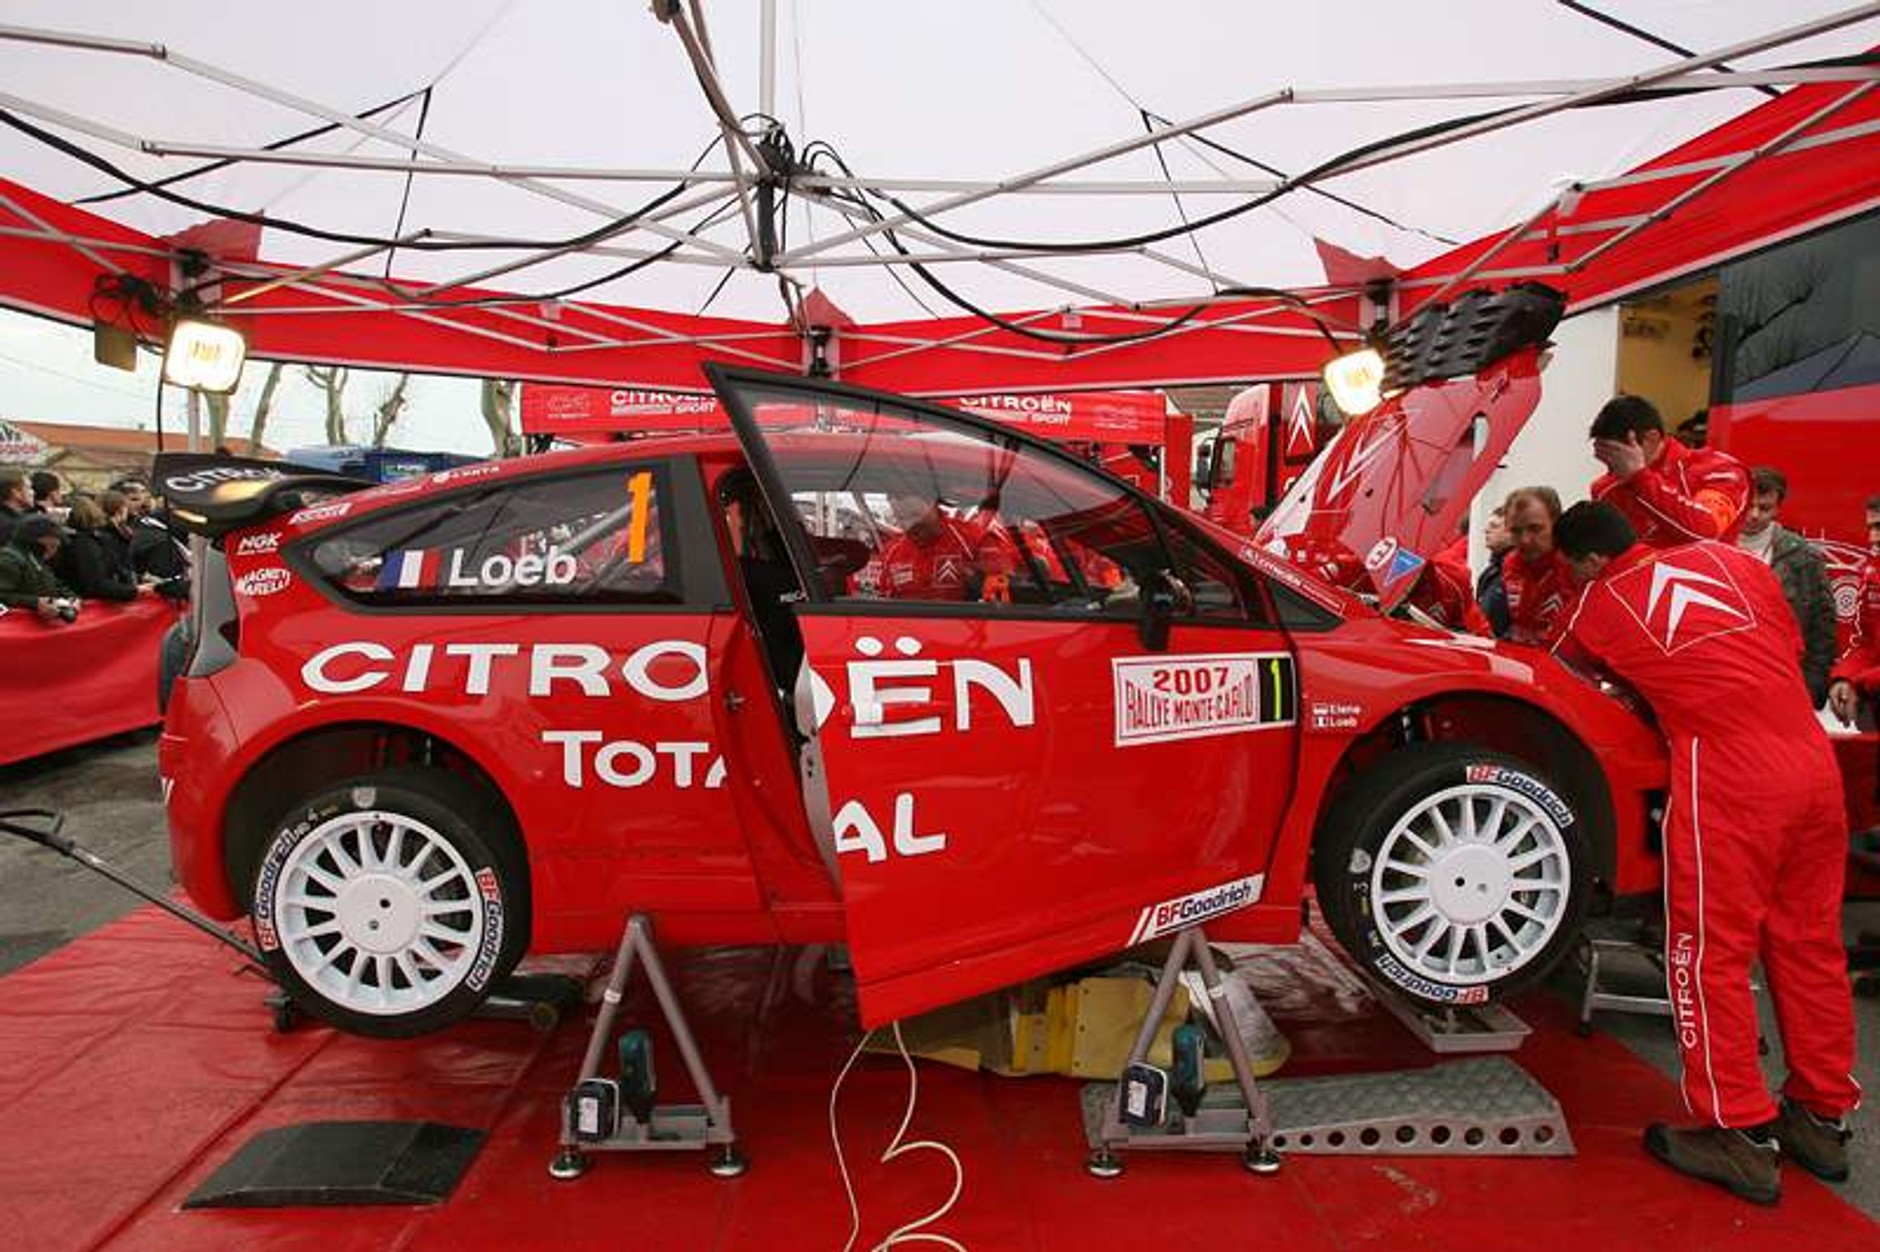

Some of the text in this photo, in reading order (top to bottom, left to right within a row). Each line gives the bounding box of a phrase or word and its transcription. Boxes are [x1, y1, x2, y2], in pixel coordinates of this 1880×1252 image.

[239, 533, 282, 551] NGK
[627, 472, 652, 564] 1
[450, 546, 577, 587] Loeb
[1126, 680, 1170, 729] RALLYE
[1153, 667, 1229, 696] 2007
[1270, 658, 1283, 721] 1
[1330, 716, 1358, 728] Loeb
[1468, 766, 1573, 827] BFGoodrich
[256, 829, 298, 949] BFGoodrich
[1156, 884, 1251, 927] BFGoodrich
[468, 867, 503, 990] BFGoodrich
[1376, 954, 1487, 1004] BFGoodrich
[1671, 932, 1698, 1049] CITROËN
